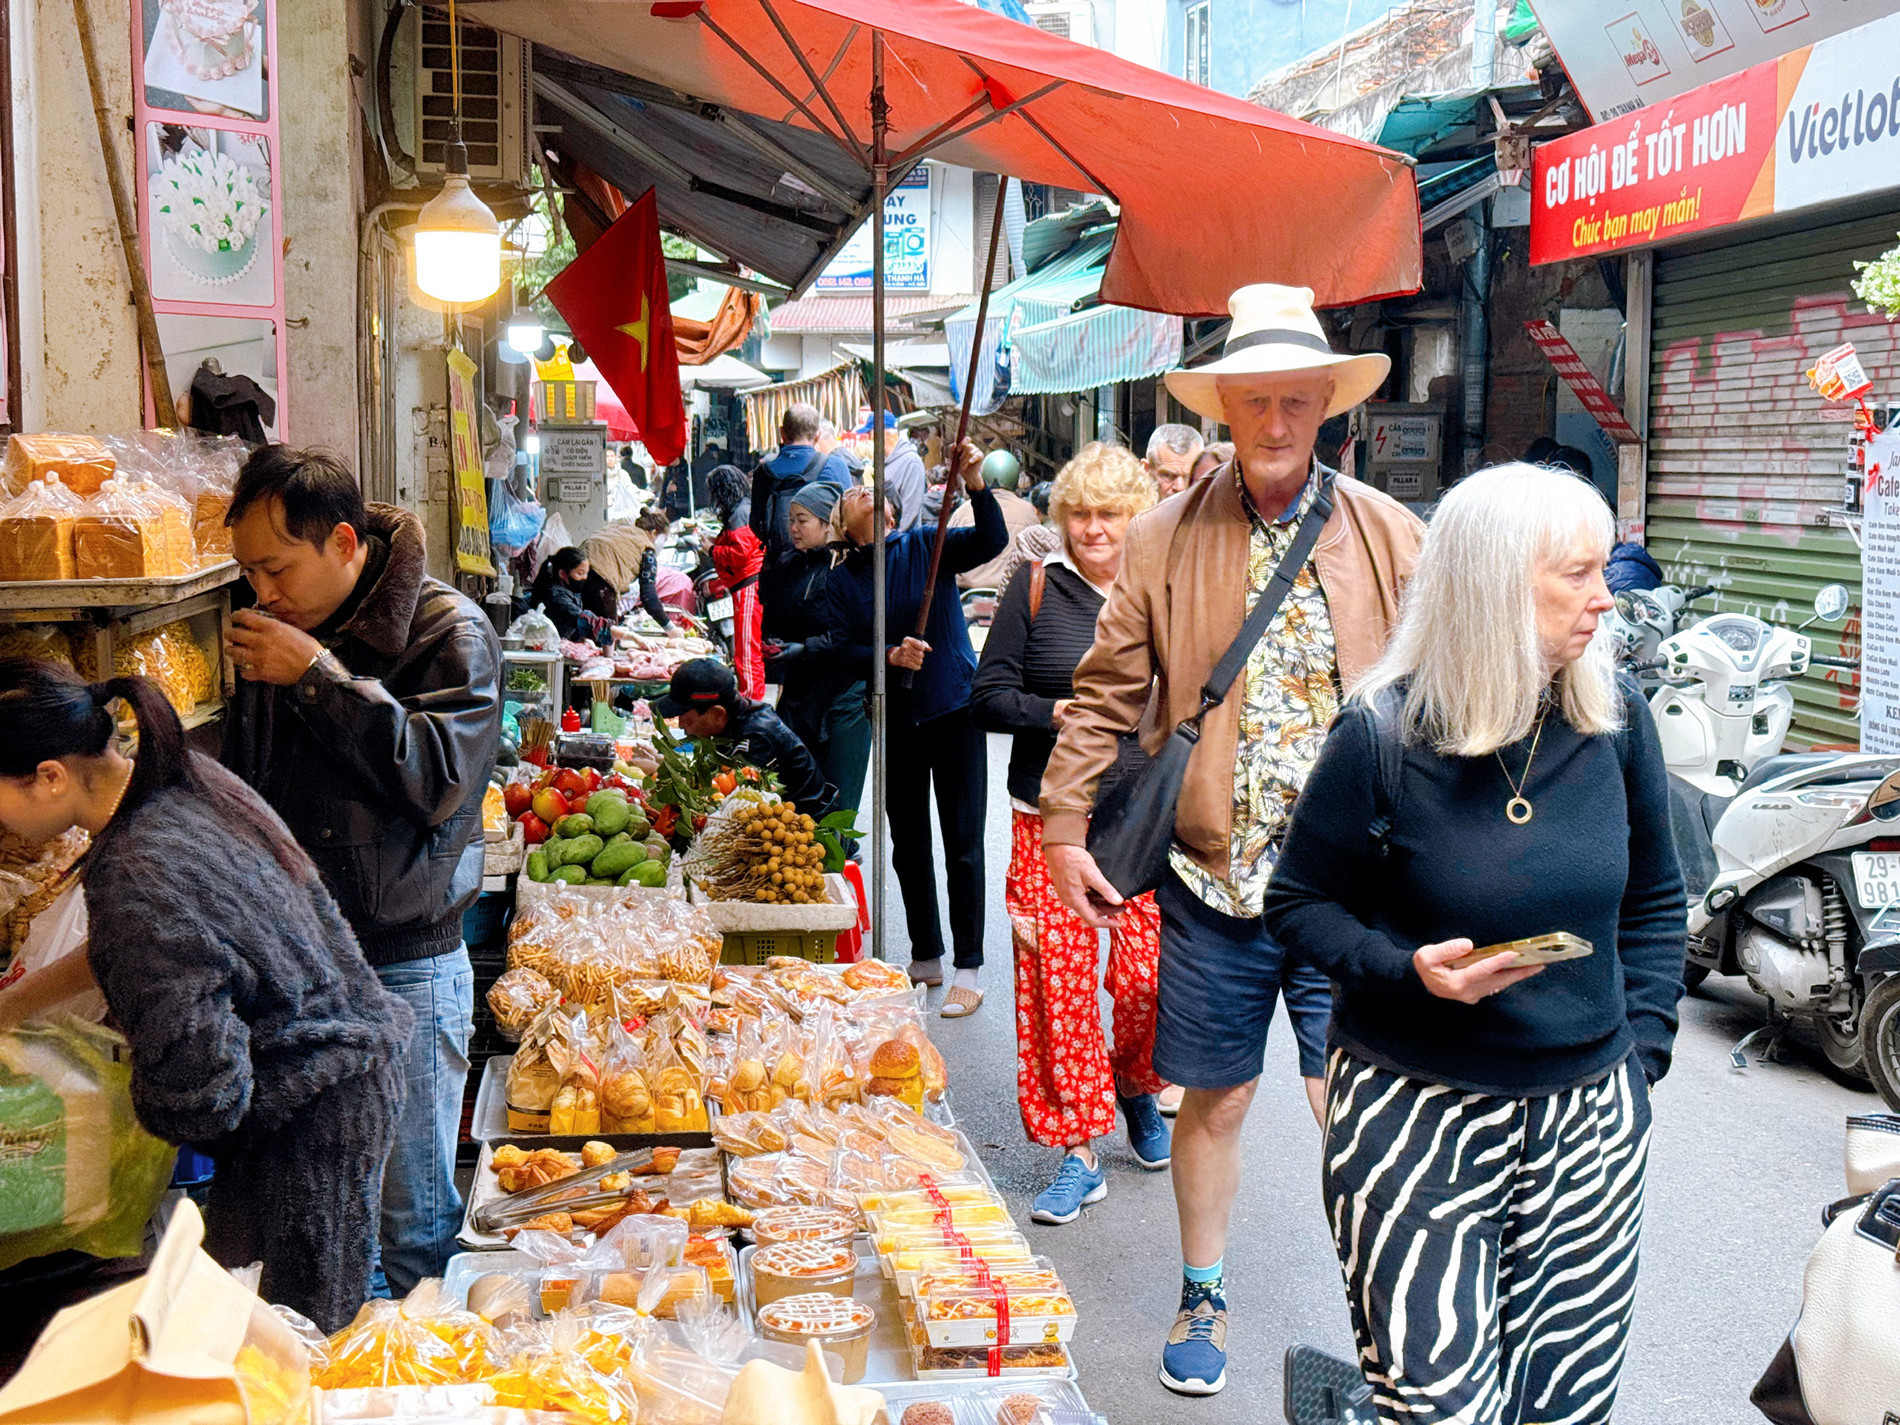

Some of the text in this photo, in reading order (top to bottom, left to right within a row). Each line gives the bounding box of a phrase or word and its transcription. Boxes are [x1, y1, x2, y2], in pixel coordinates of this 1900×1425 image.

[1624, 50, 1647, 67] Mega
[1546, 102, 1747, 209] CƠ HỘI ĐỂ TỐT HƠN
[884, 195, 906, 207] AY
[1572, 185, 1702, 248] Chúc bạn may mắn!
[1878, 475, 1900, 497] Cafe
[1884, 502, 1900, 516] Take
[1865, 856, 1900, 878] 29-
